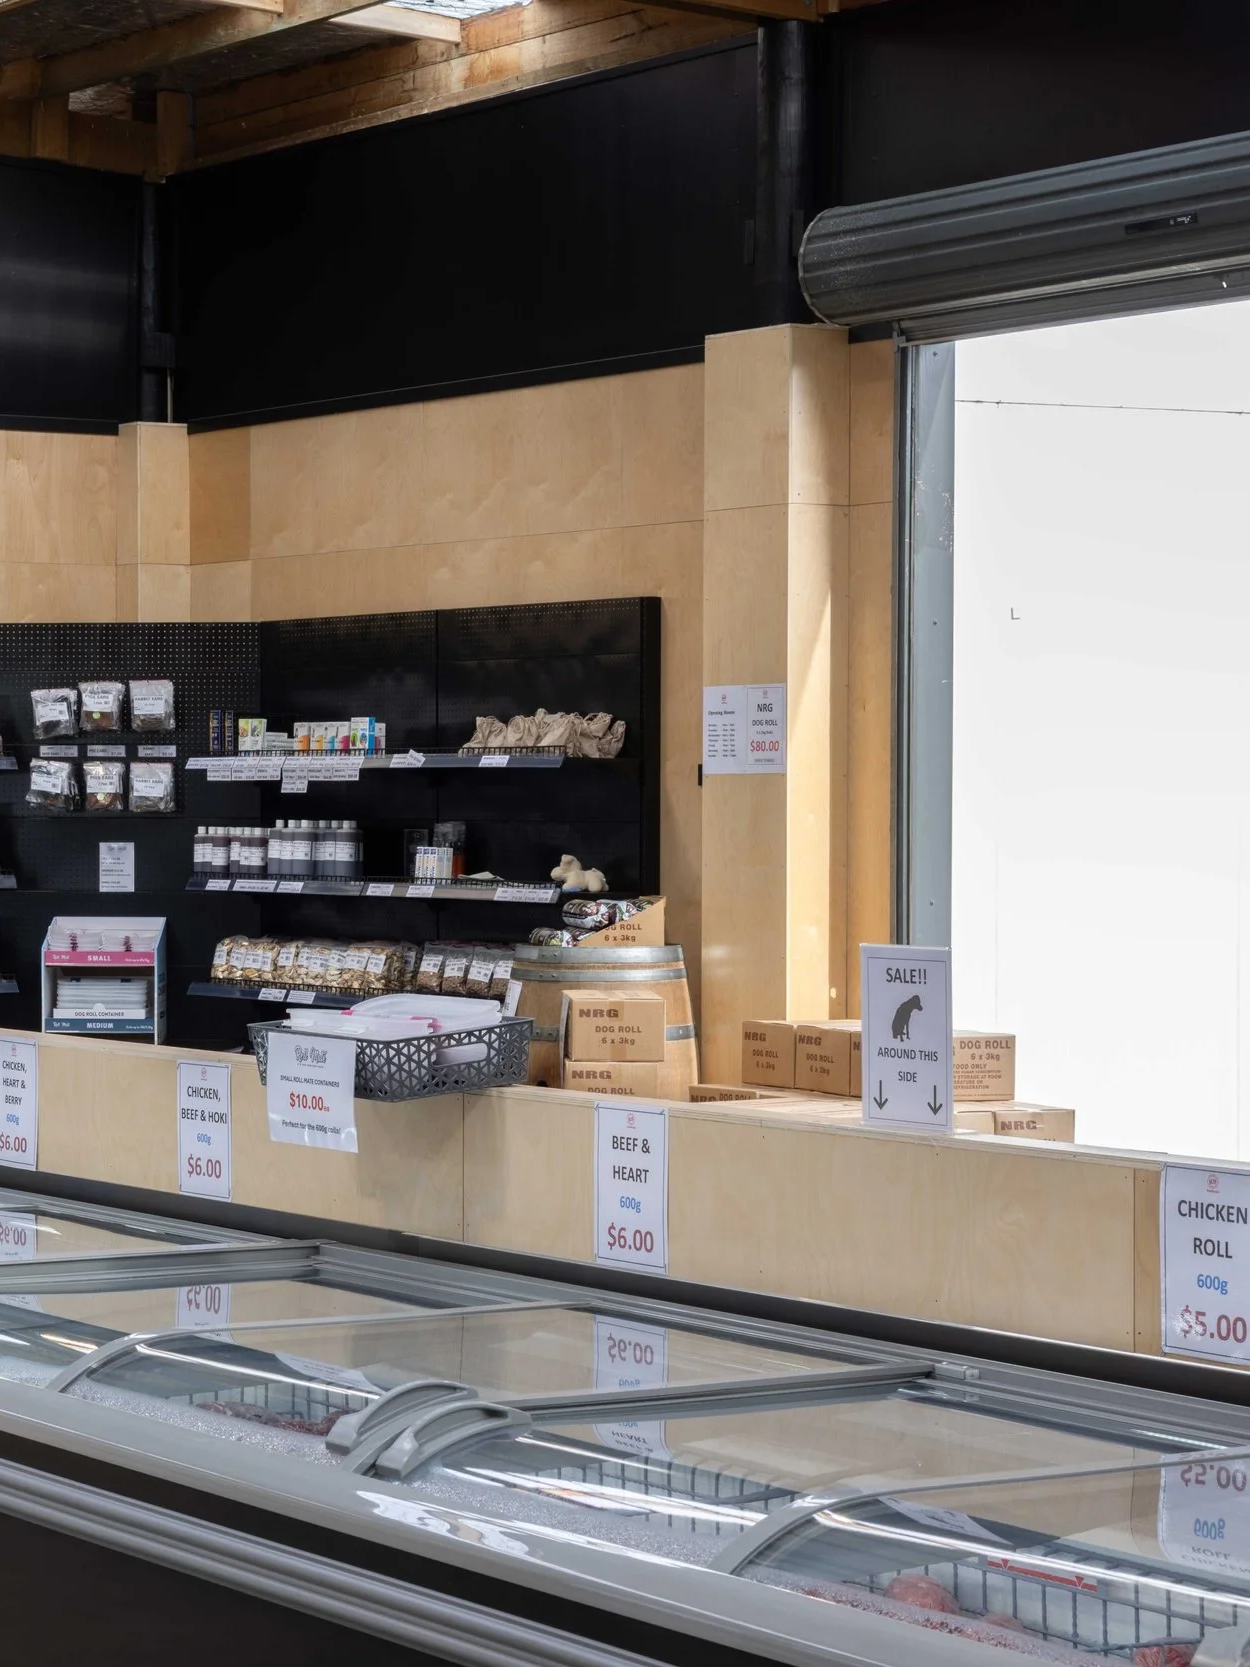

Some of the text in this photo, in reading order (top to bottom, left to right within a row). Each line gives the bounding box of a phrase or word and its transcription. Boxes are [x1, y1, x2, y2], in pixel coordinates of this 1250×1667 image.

[756, 703, 773, 713] NRG
[750, 740, 779, 753] $80.00
[620, 935, 636, 943] 3kg
[886, 967, 927, 985] SALE!!
[578, 1009, 619, 1018] NRG
[744, 1032, 766, 1041] NRG
[798, 1035, 822, 1045] NRG
[960, 1040, 1011, 1049] DOG ROLL
[752, 1049, 778, 1058] DOG ROLL
[806, 1053, 834, 1063] DOG ROLL
[877, 1046, 938, 1062] AROUND THIS
[986, 1053, 1000, 1061] 3kg
[2, 1060, 27, 1073] CHICKEN,
[571, 1070, 612, 1079] NRG
[898, 1071, 917, 1082] SIDE
[2, 1078, 26, 1089] HEART &
[315, 1079, 340, 1088] CONTAINERS
[5, 1095, 22, 1106] BERRY
[187, 1086, 221, 1102] CHICKEN,
[6, 1113, 20, 1126] 600g
[181, 1108, 227, 1124] BEEF & HOKI
[282, 1119, 299, 1128] Perfect
[315, 1124, 327, 1134] 600g
[0, 1132, 27, 1153] $6.00
[197, 1133, 211, 1145] 600g
[612, 1135, 650, 1154] BEEF &
[187, 1154, 222, 1179] $6.00
[613, 1165, 649, 1184] HEART
[620, 1196, 641, 1213] 600g
[1177, 1199, 1248, 1224] CHICKEN
[607, 1222, 654, 1253] $6.00
[1193, 1237, 1233, 1259] ROLL
[1197, 1273, 1228, 1295] 600g
[1180, 1304, 1247, 1343] $5.00
